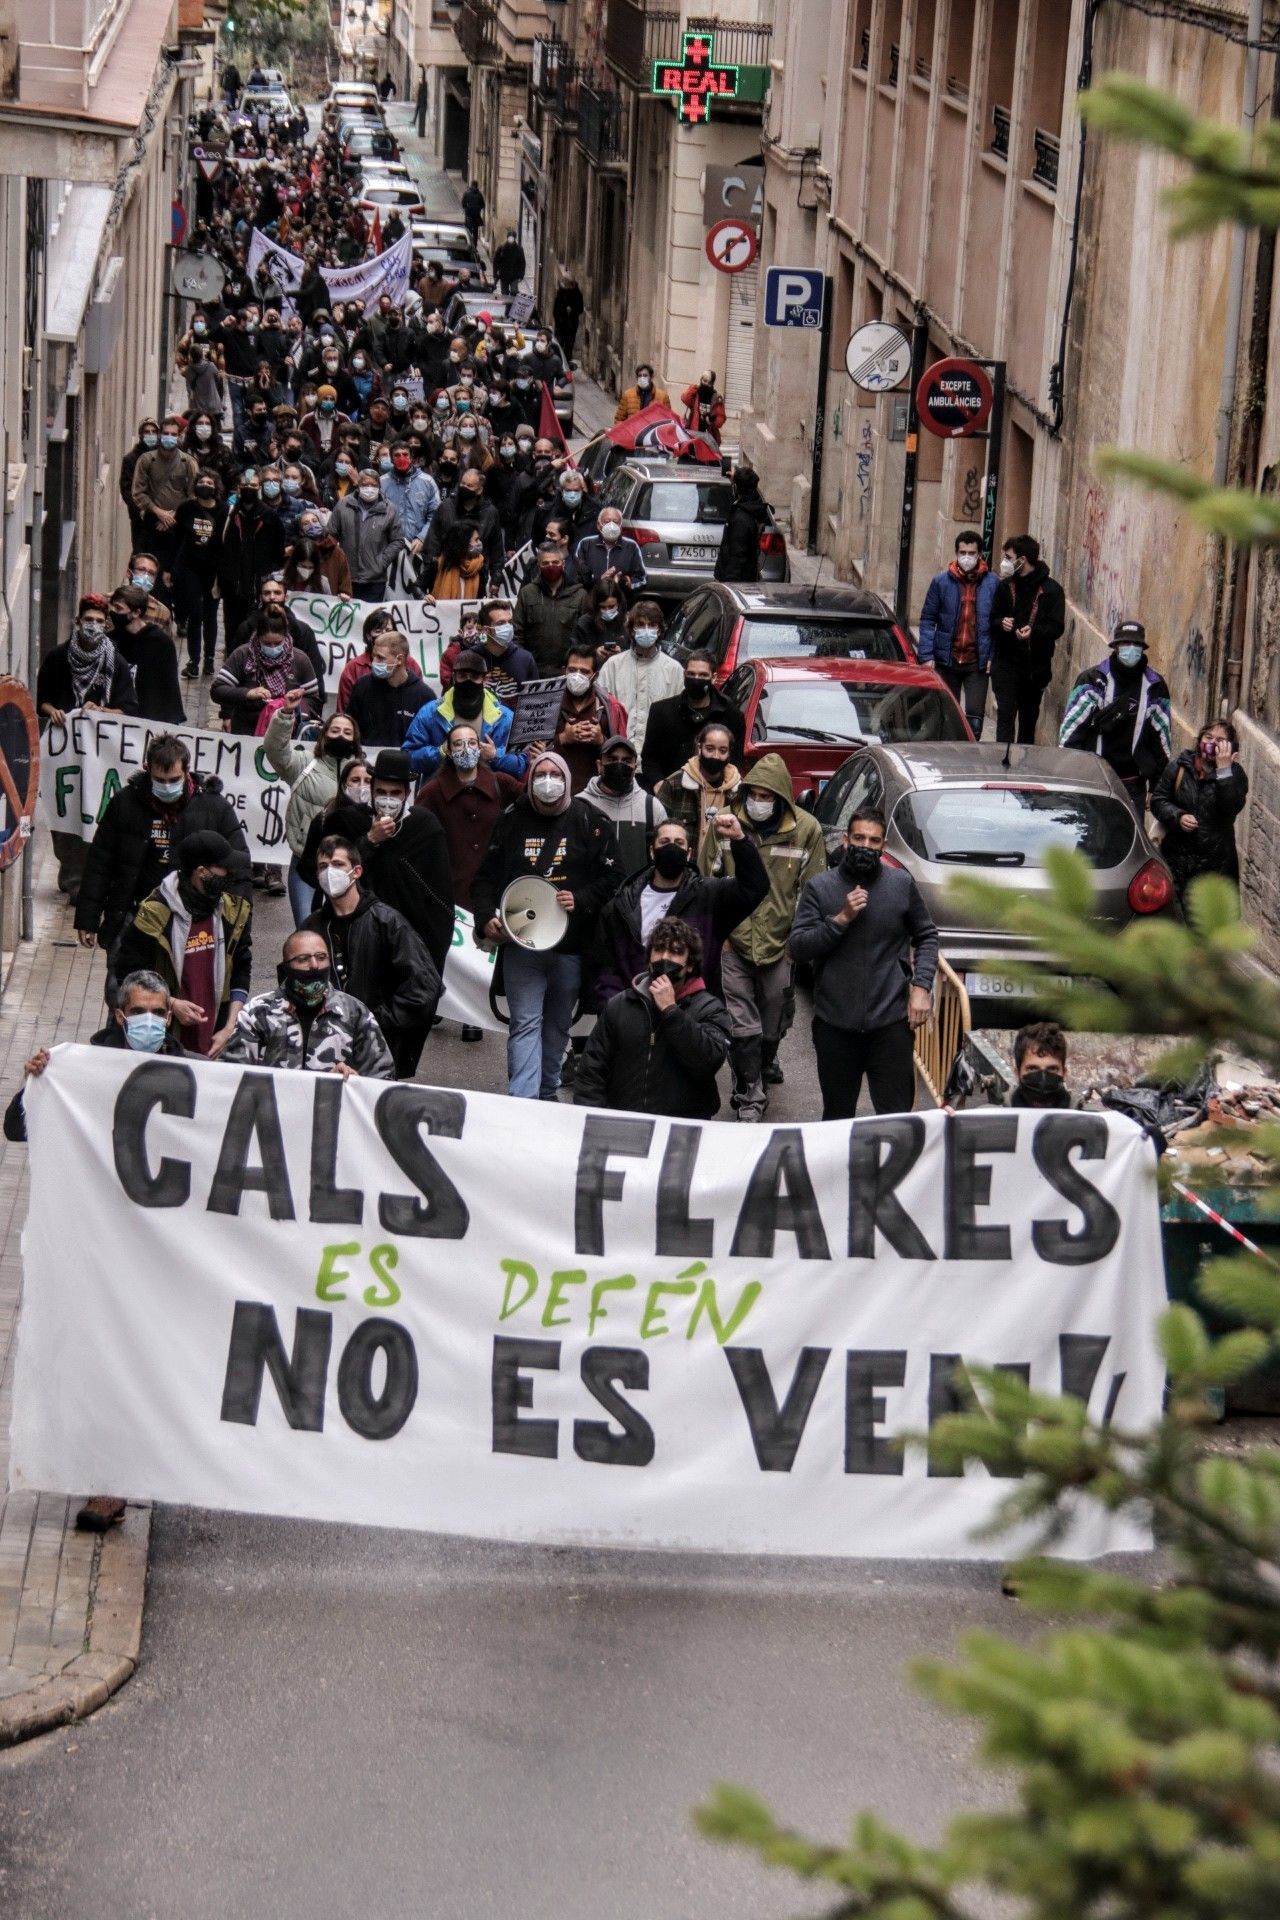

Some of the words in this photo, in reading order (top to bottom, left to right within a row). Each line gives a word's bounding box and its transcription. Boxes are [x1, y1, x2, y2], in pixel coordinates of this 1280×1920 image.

[663, 69, 734, 94] REAL
[776, 274, 812, 321] P
[928, 395, 981, 407] AMBULÀNCIES
[940, 380, 971, 391] EXCEPTE
[680, 547, 706, 558] 7450
[48, 716, 242, 777] DEFEEM
[111, 1059, 471, 1240] CALS
[574, 1113, 1122, 1266] FLARES
[314, 1242, 402, 1307] ES
[498, 1258, 762, 1344] DEFÉN
[220, 1300, 419, 1441] NO
[492, 1334, 656, 1467] ES
